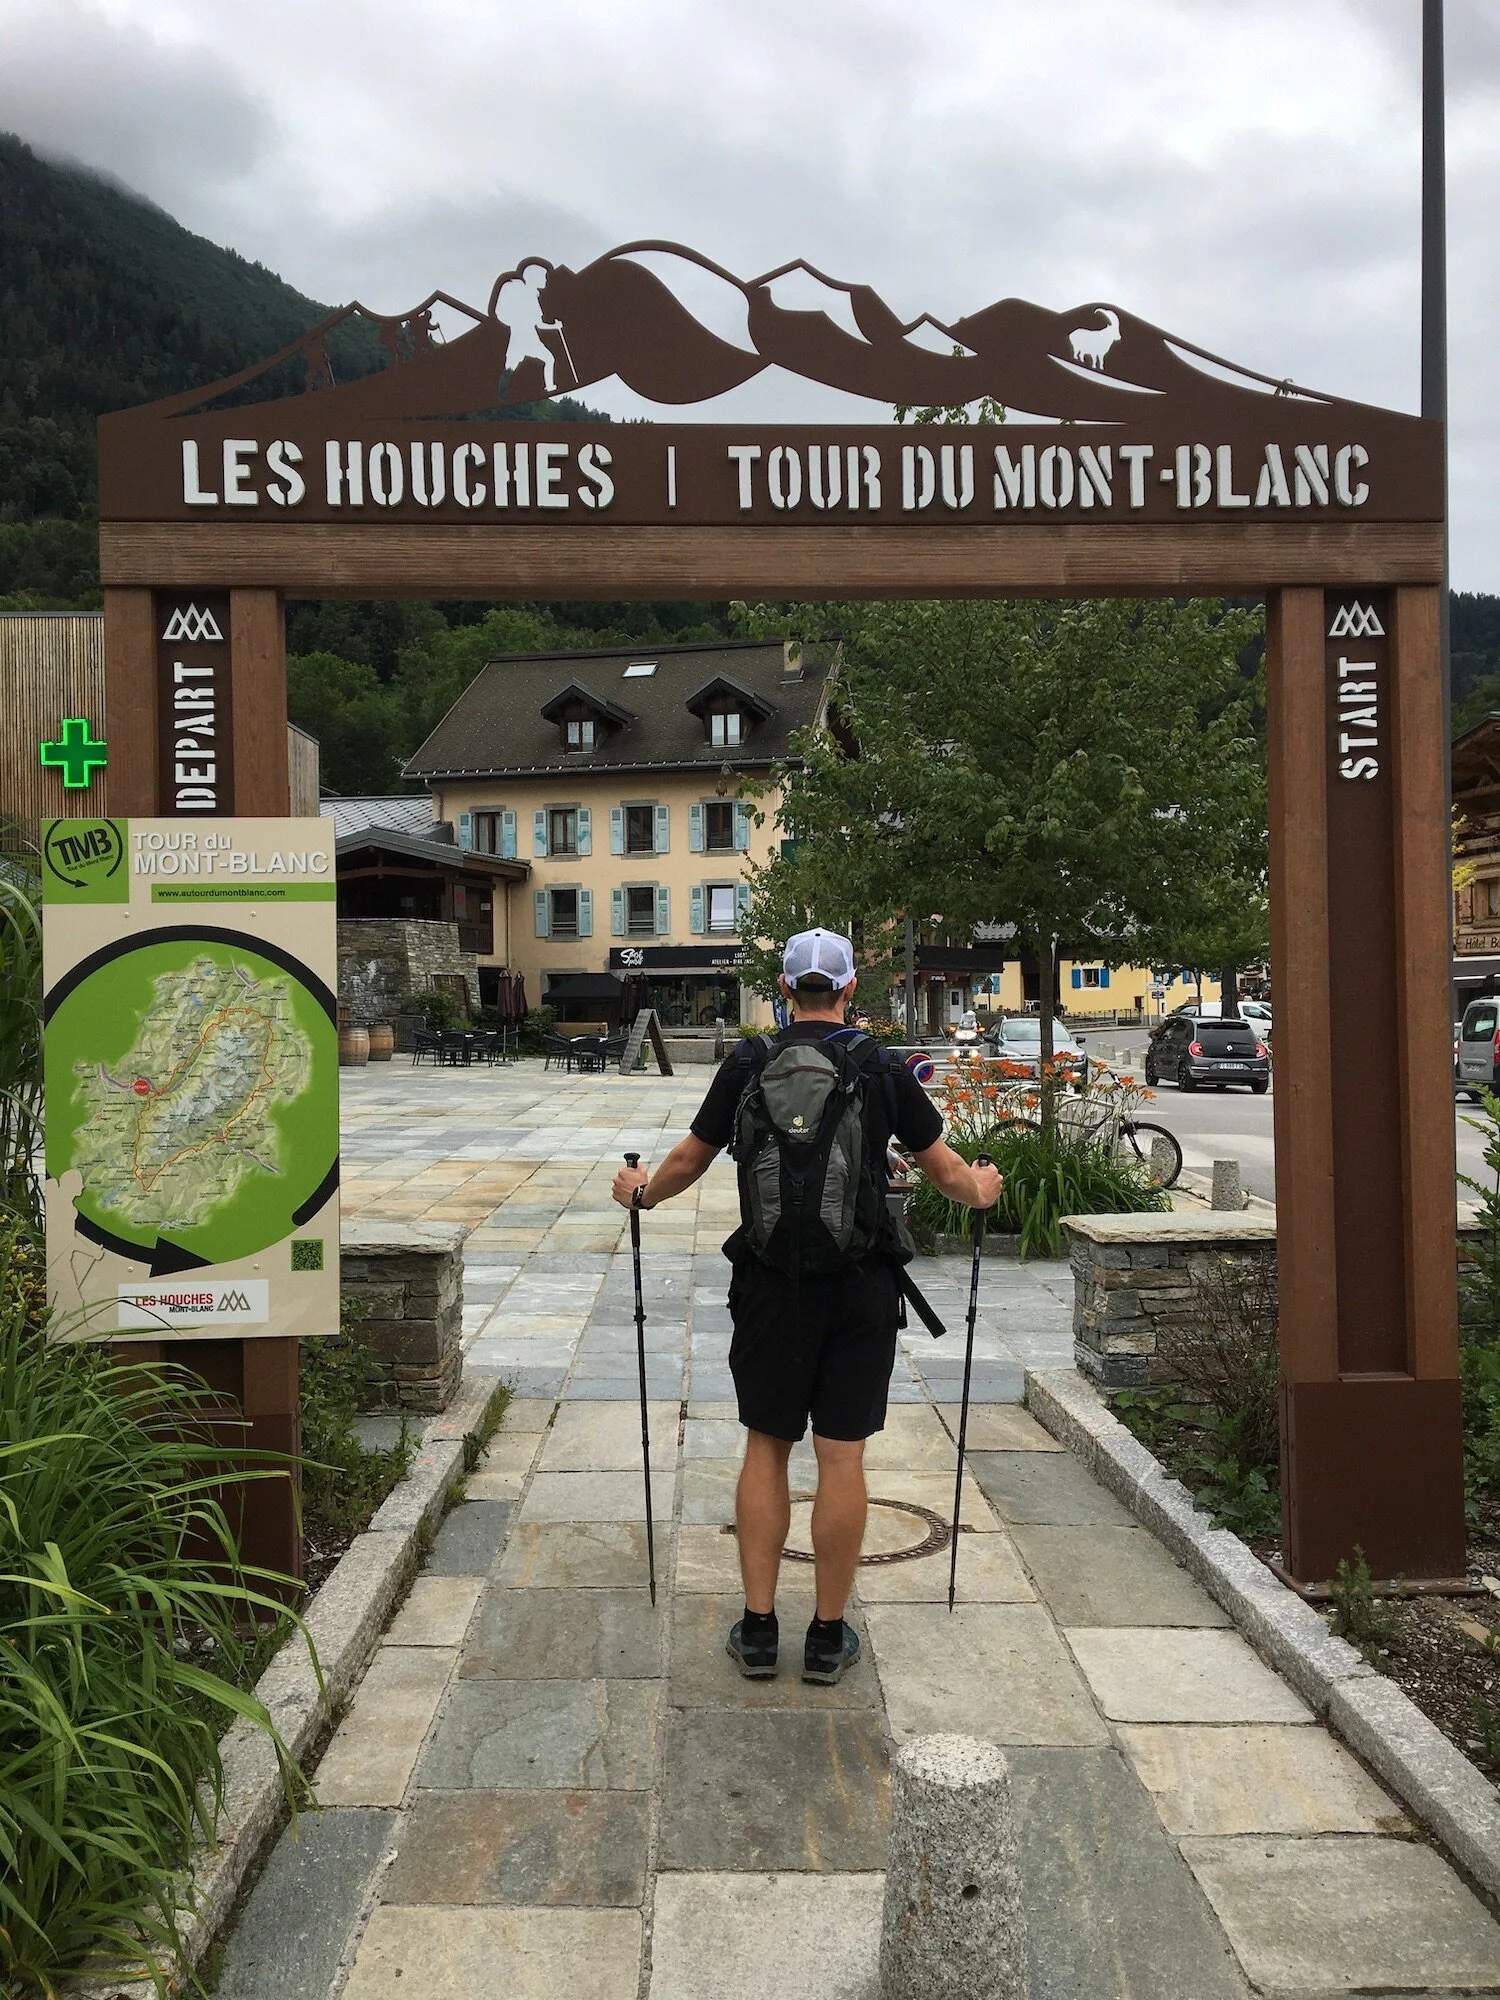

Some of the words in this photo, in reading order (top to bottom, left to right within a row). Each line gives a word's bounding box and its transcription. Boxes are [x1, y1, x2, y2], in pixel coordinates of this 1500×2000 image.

[182, 439, 304, 505] LES
[325, 440, 614, 507] HOUCHES
[727, 445, 881, 509] TOUR
[902, 445, 974, 509] DU
[994, 443, 1370, 508] MONT-BLANC
[1339, 656, 1379, 780] START
[173, 661, 217, 809] DEPART
[51, 828, 112, 866] TMB
[133, 832, 199, 851] TOUR
[204, 832, 232, 851] du
[134, 851, 329, 875] MONT-BLANC
[158, 888, 286, 899] www.autourdumontblanc.com
[1465, 936, 1486, 949] Hôtel
[134, 1294, 157, 1308] LES
[159, 1293, 214, 1306] HOUCHES
[168, 1305, 214, 1314] MONT-BLANC
